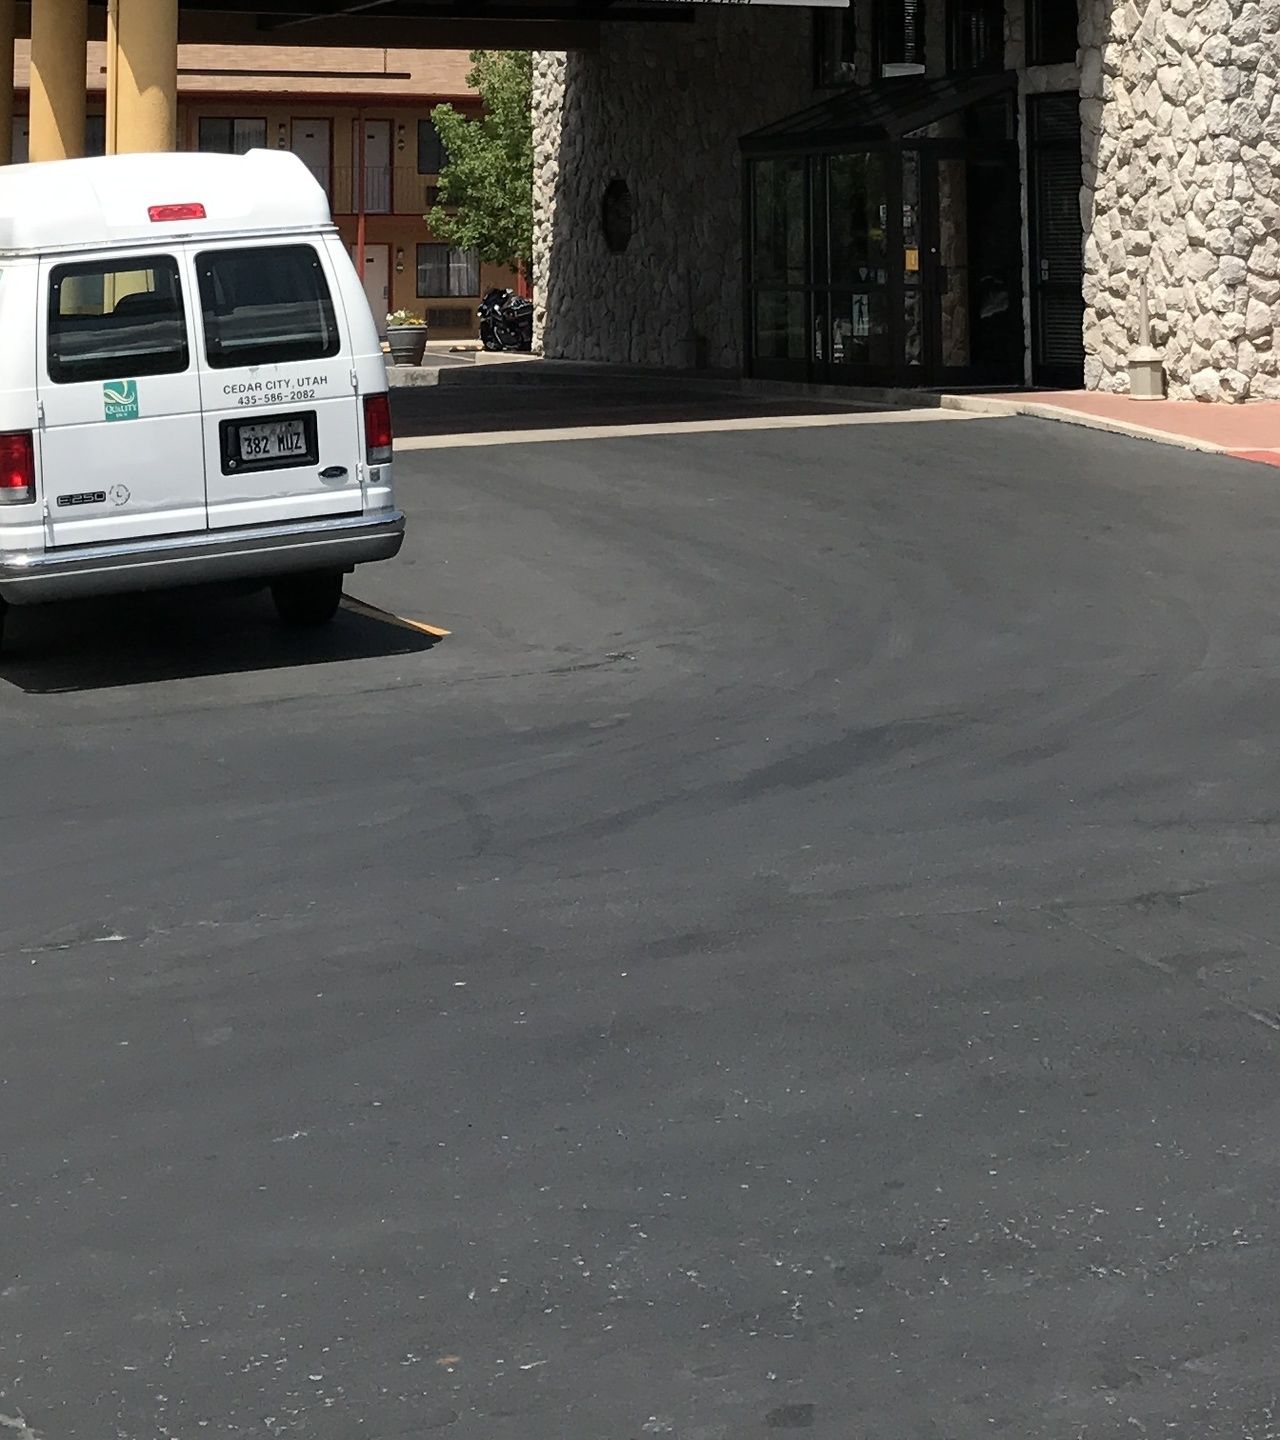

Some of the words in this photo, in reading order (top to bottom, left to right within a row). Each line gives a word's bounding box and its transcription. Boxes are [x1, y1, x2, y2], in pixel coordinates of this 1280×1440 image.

[223, 382, 262, 395] CEDAR
[265, 379, 295, 391] CITY,
[297, 376, 328, 387] UTAH
[238, 389, 315, 405] 435-586-2082
[243, 436, 270, 455] 382
[277, 432, 302, 452] MUZ
